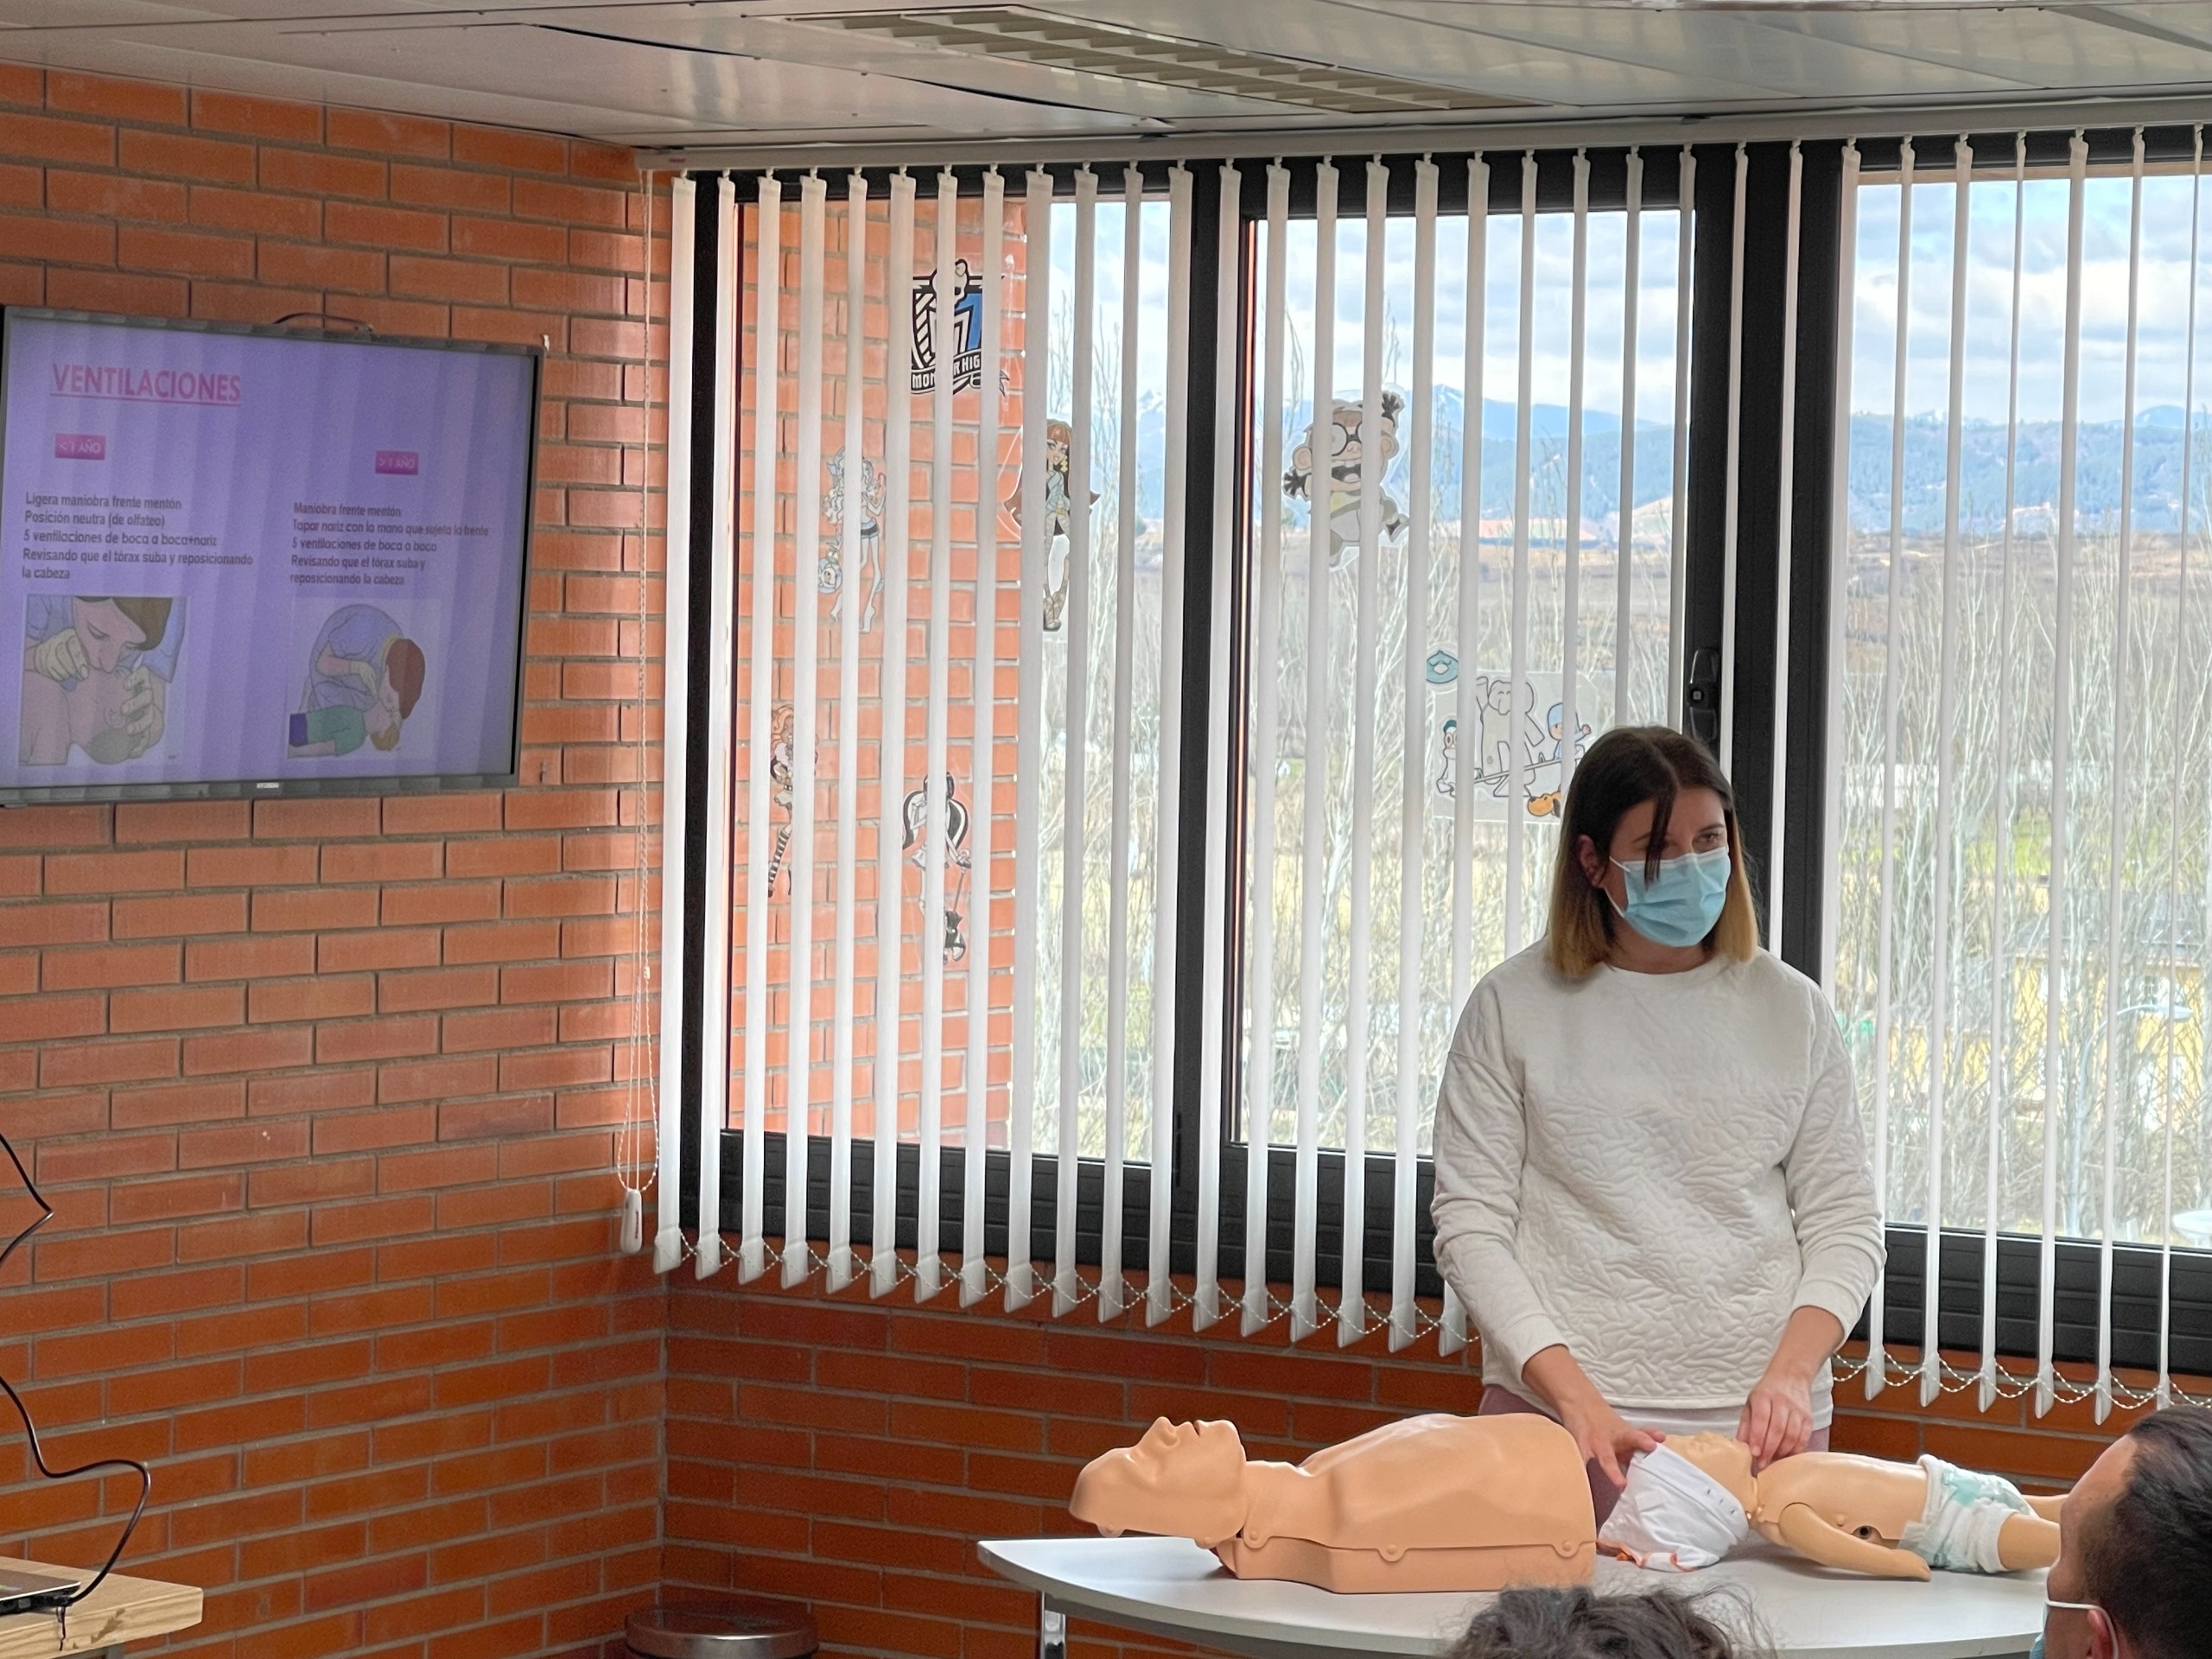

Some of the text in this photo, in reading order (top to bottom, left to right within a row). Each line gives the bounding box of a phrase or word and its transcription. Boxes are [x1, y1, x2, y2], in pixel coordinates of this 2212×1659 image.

[961, 354, 982, 373] HIG
[53, 364, 241, 402] VENTILACIONES
[79, 439, 101, 454] AÑO
[26, 492, 181, 509] Ligera maniobra frente mentón
[294, 502, 401, 517] Maniobra frente mentón
[24, 510, 165, 530] Posición neutra (de olfateo)
[293, 518, 319, 533] Tapar
[321, 520, 344, 532] nariz
[346, 523, 363, 532] con
[365, 520, 374, 532] la
[378, 524, 403, 534] mano
[405, 525, 423, 537] que
[454, 524, 462, 536] la
[23, 529, 217, 546] 5 ventilaciones de boca a boca+nariz
[292, 537, 437, 551] 5 ventilaciones de boca a boca
[23, 547, 253, 566] Revisando que el tórax suba y reposicionando
[291, 555, 425, 571] Revisando que el tórax suba y
[22, 566, 70, 579] la cabeza
[290, 573, 404, 586] reposicionando la cabeza
